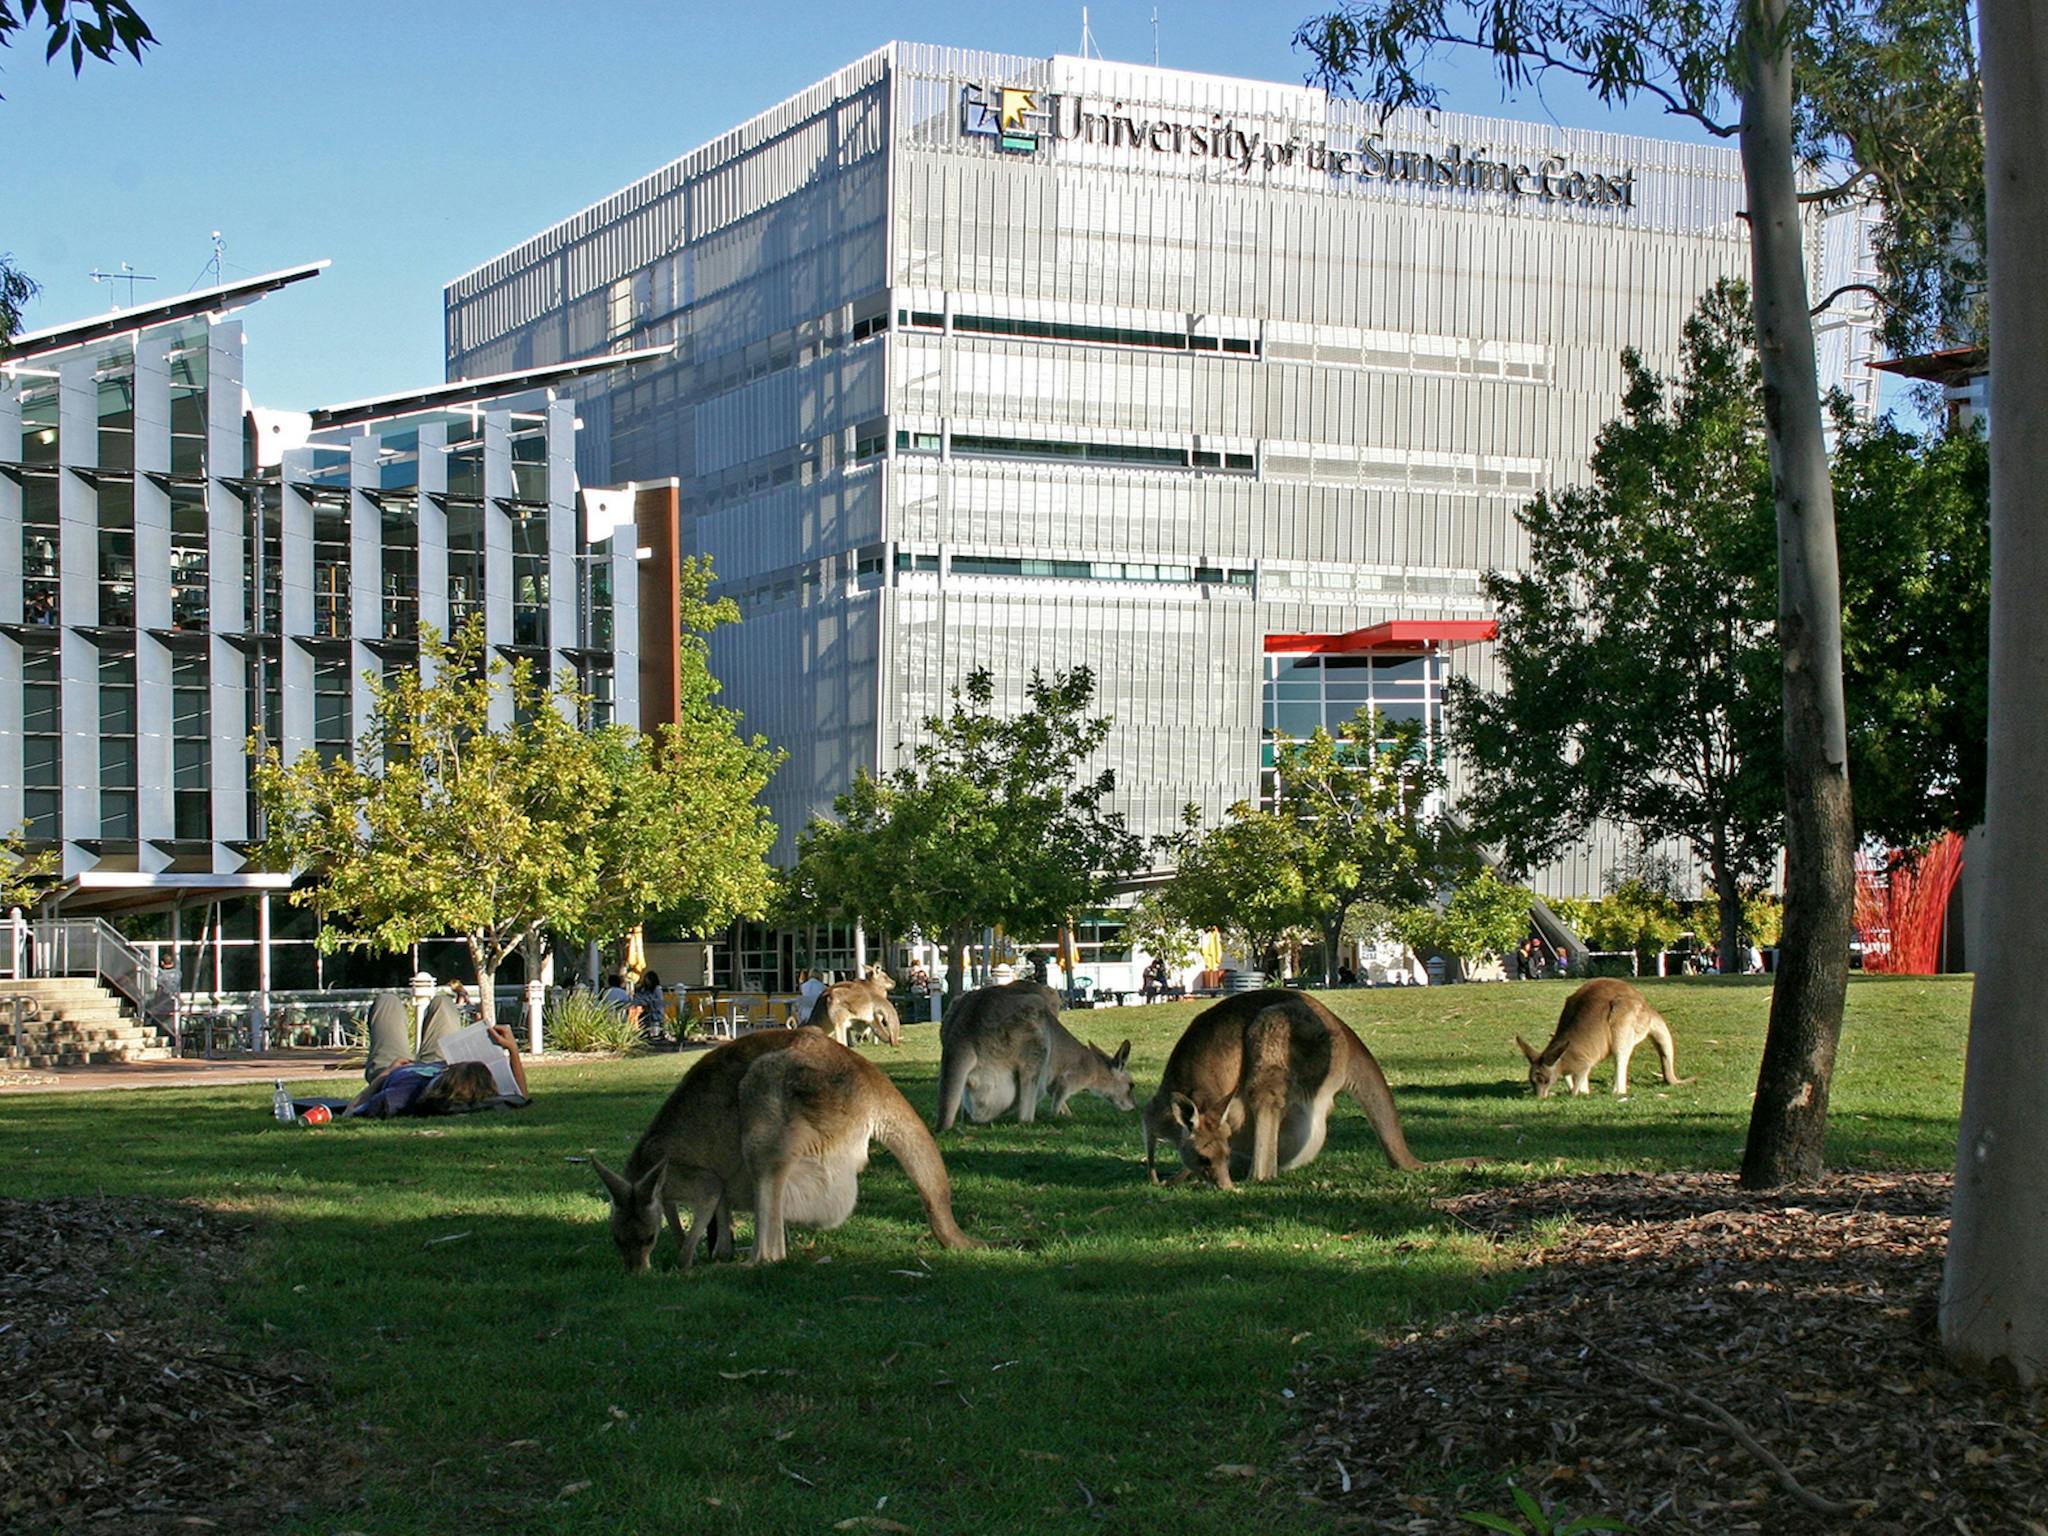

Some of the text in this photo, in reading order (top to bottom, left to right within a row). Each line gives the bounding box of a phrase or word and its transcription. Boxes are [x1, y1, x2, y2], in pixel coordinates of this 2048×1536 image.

[1051, 93, 1637, 207] University of the Sunshine Coast
